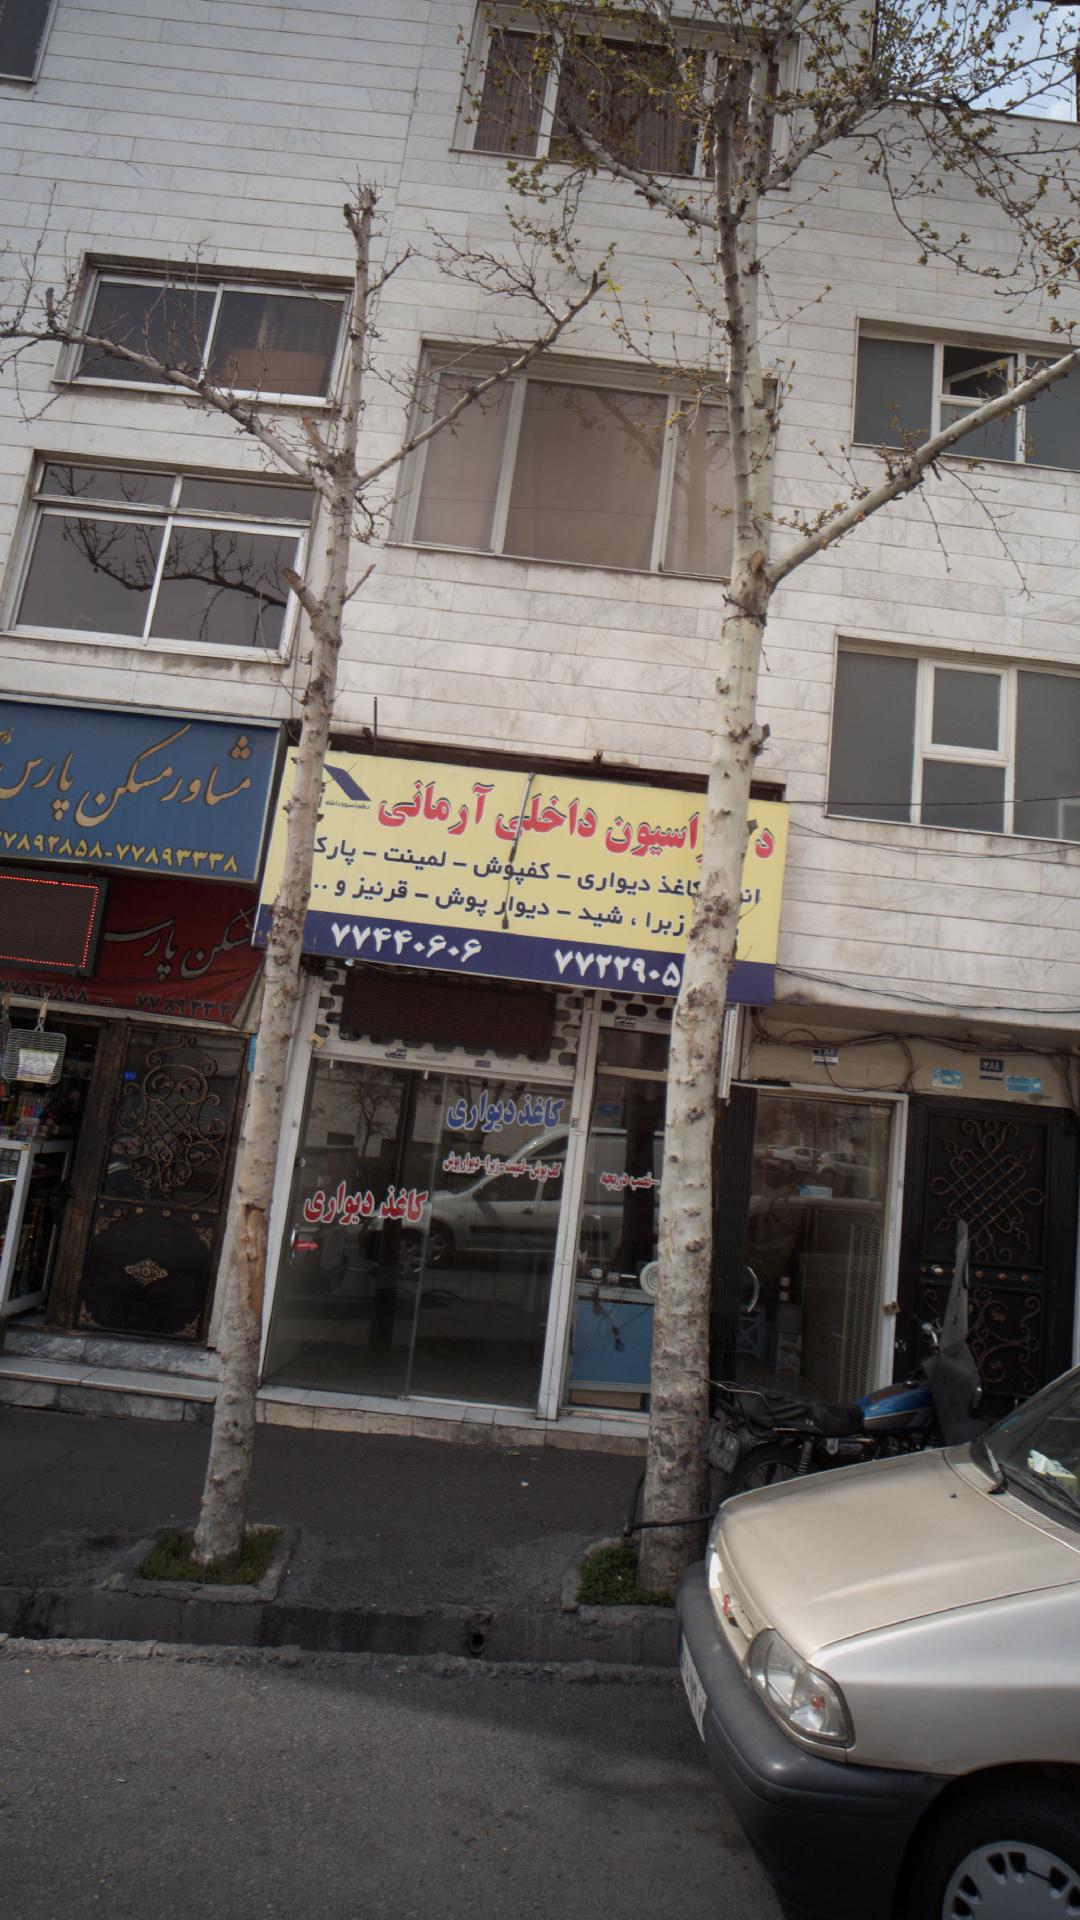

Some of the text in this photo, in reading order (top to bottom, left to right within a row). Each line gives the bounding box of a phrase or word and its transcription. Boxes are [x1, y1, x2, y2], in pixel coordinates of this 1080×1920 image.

[75, 723, 192, 827] مسکن
[160, 735, 251, 806] مشاور
[378, 779, 775, 864] داسیون داخلی آرمانی
[313, 837, 356, 867] پارک
[384, 847, 447, 871] لمینت
[352, 877, 408, 903] قرنیز
[577, 871, 651, 896] دیواری
[578, 906, 624, 928] شید
[646, 912, 685, 937] زبرا
[180, 906, 255, 979] سکن
[331, 922, 682, 988] ۷۷۴۴۰۶۰۶ ۷۷۲۲۹۰۵
[447, 1089, 565, 1133] کاغذ دیواری
[303, 1180, 429, 1226] کاغذ دیواری
